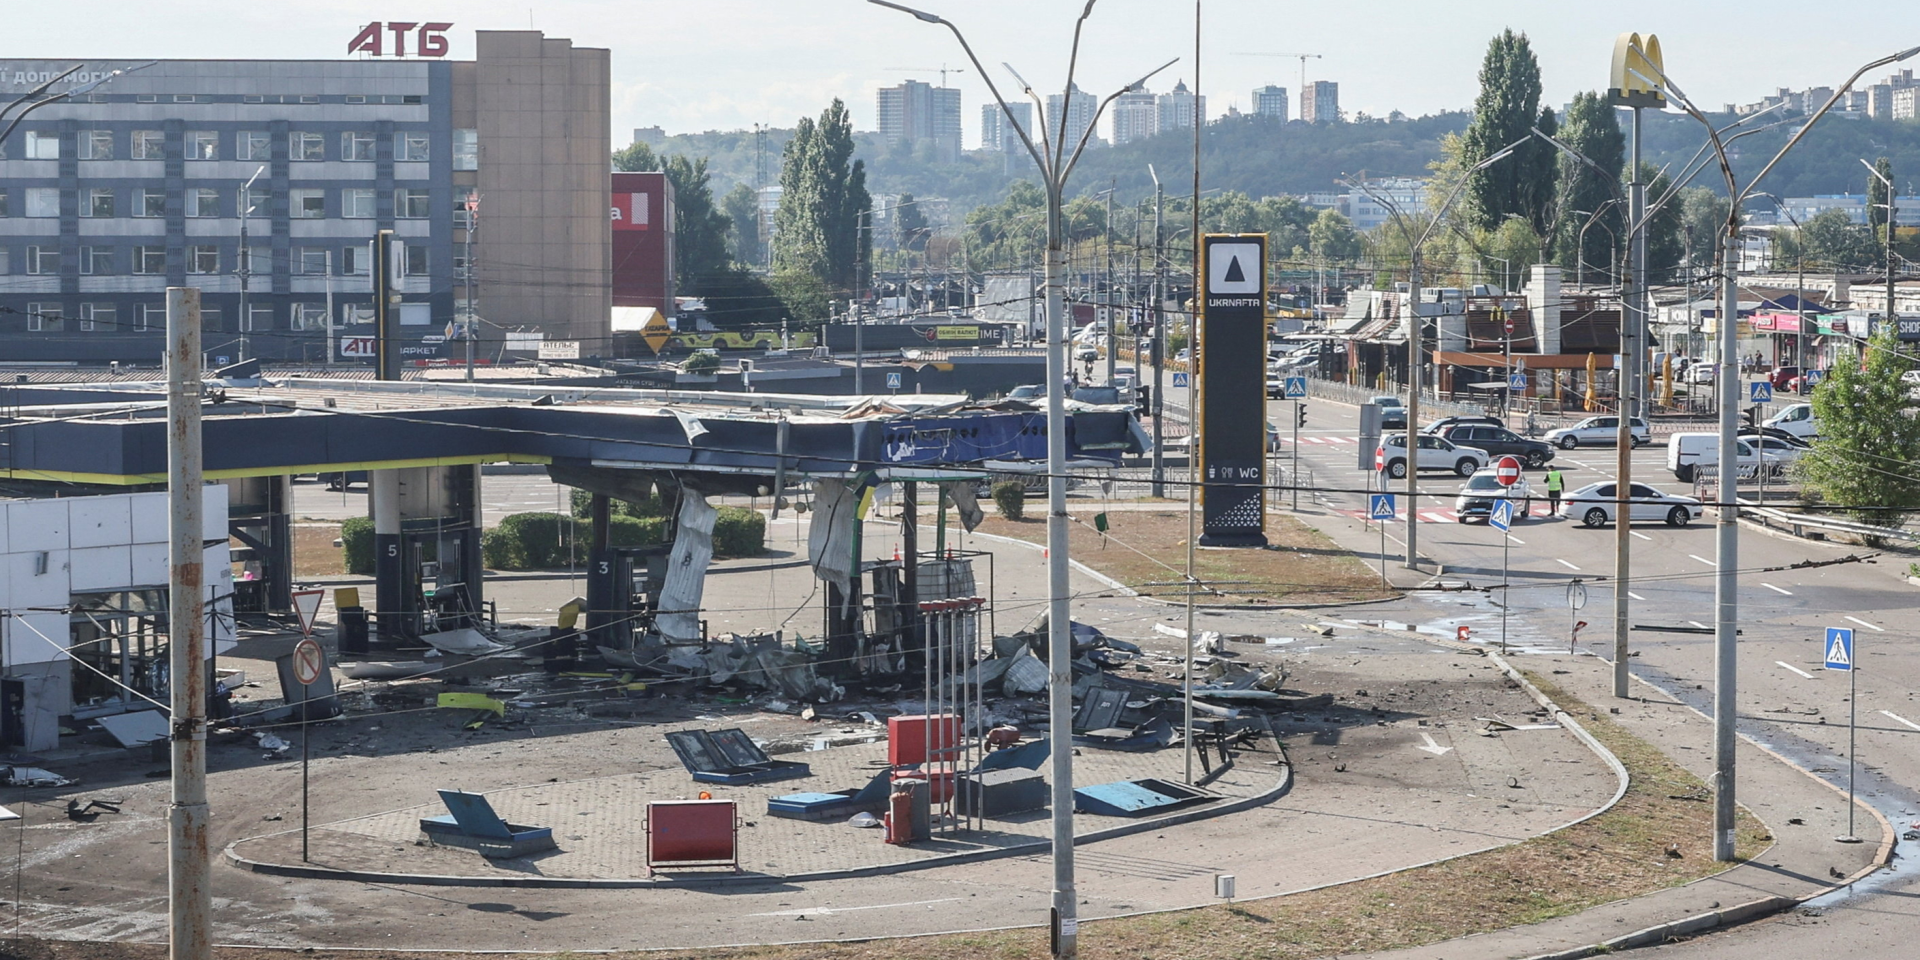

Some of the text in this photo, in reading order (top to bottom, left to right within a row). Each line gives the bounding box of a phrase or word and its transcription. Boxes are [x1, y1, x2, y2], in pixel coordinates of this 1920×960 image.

[348, 21, 455, 57] АТБ
[1209, 299, 1260, 307] UKRNAFTA
[980, 330, 1000, 339] IME
[1239, 467, 1258, 478] WC
[389, 544, 397, 556] 5
[599, 561, 608, 574] 3
